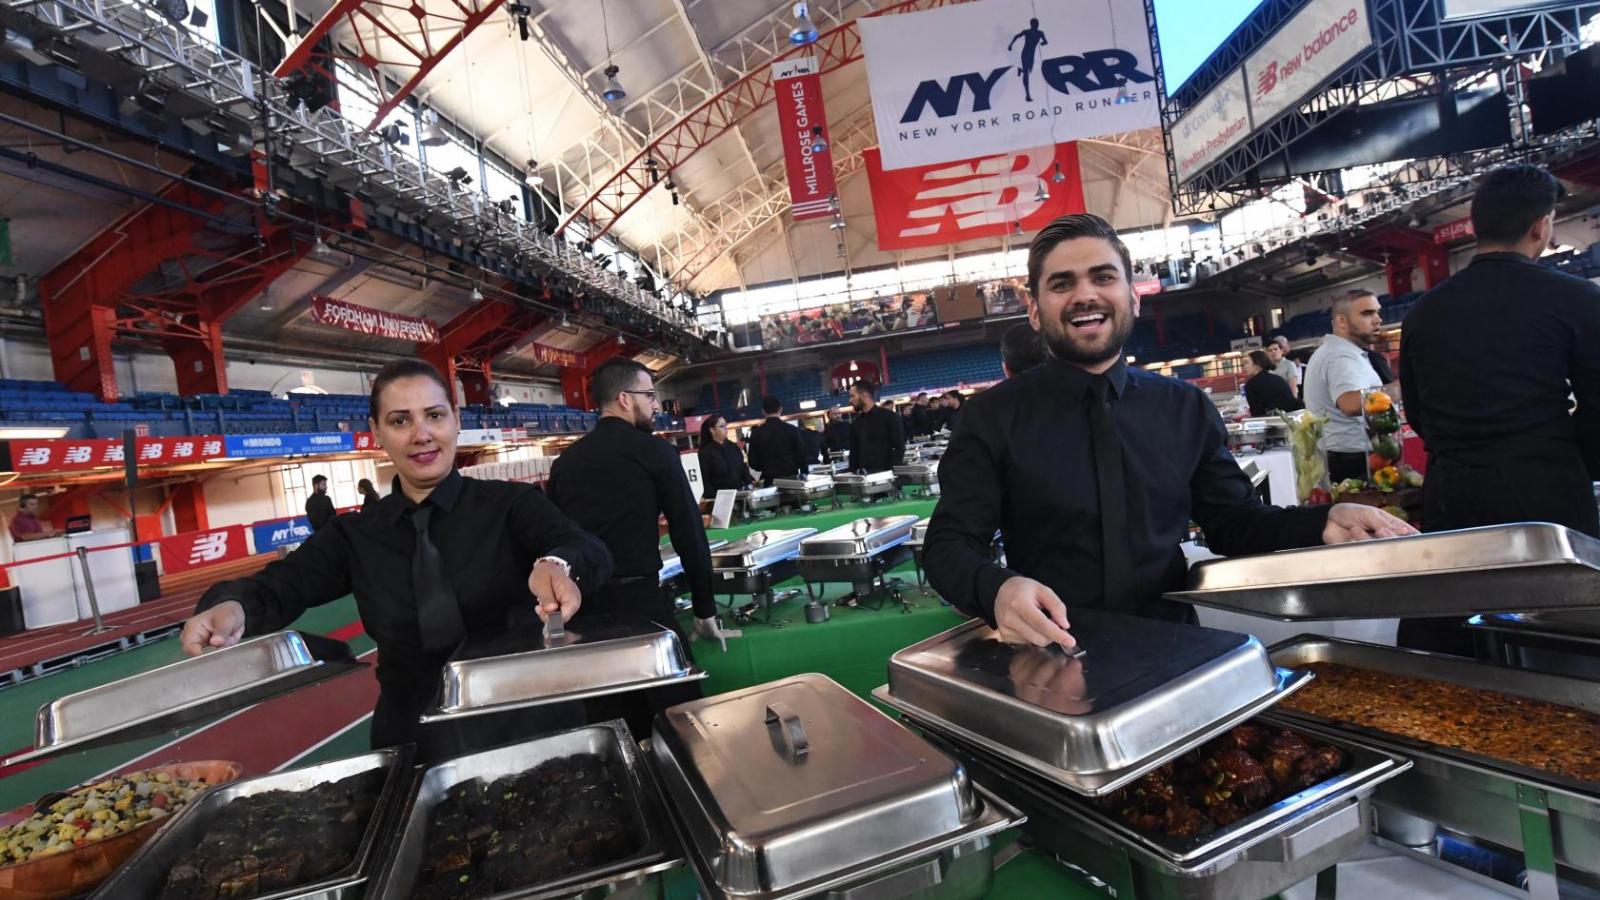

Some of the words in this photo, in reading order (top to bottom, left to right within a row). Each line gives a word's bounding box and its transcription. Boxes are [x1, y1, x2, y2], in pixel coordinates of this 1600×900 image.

[1280, 52, 1302, 81] new
[1303, 8, 1358, 61] balance
[791, 81, 809, 128] GAMES
[899, 128, 938, 142] NEW
[950, 116, 1000, 133] YORK
[1012, 105, 1063, 123] ROAD
[1075, 90, 1152, 112] RUNER
[798, 129, 819, 195] MILLROSE
[325, 303, 377, 327] FORDHAM
